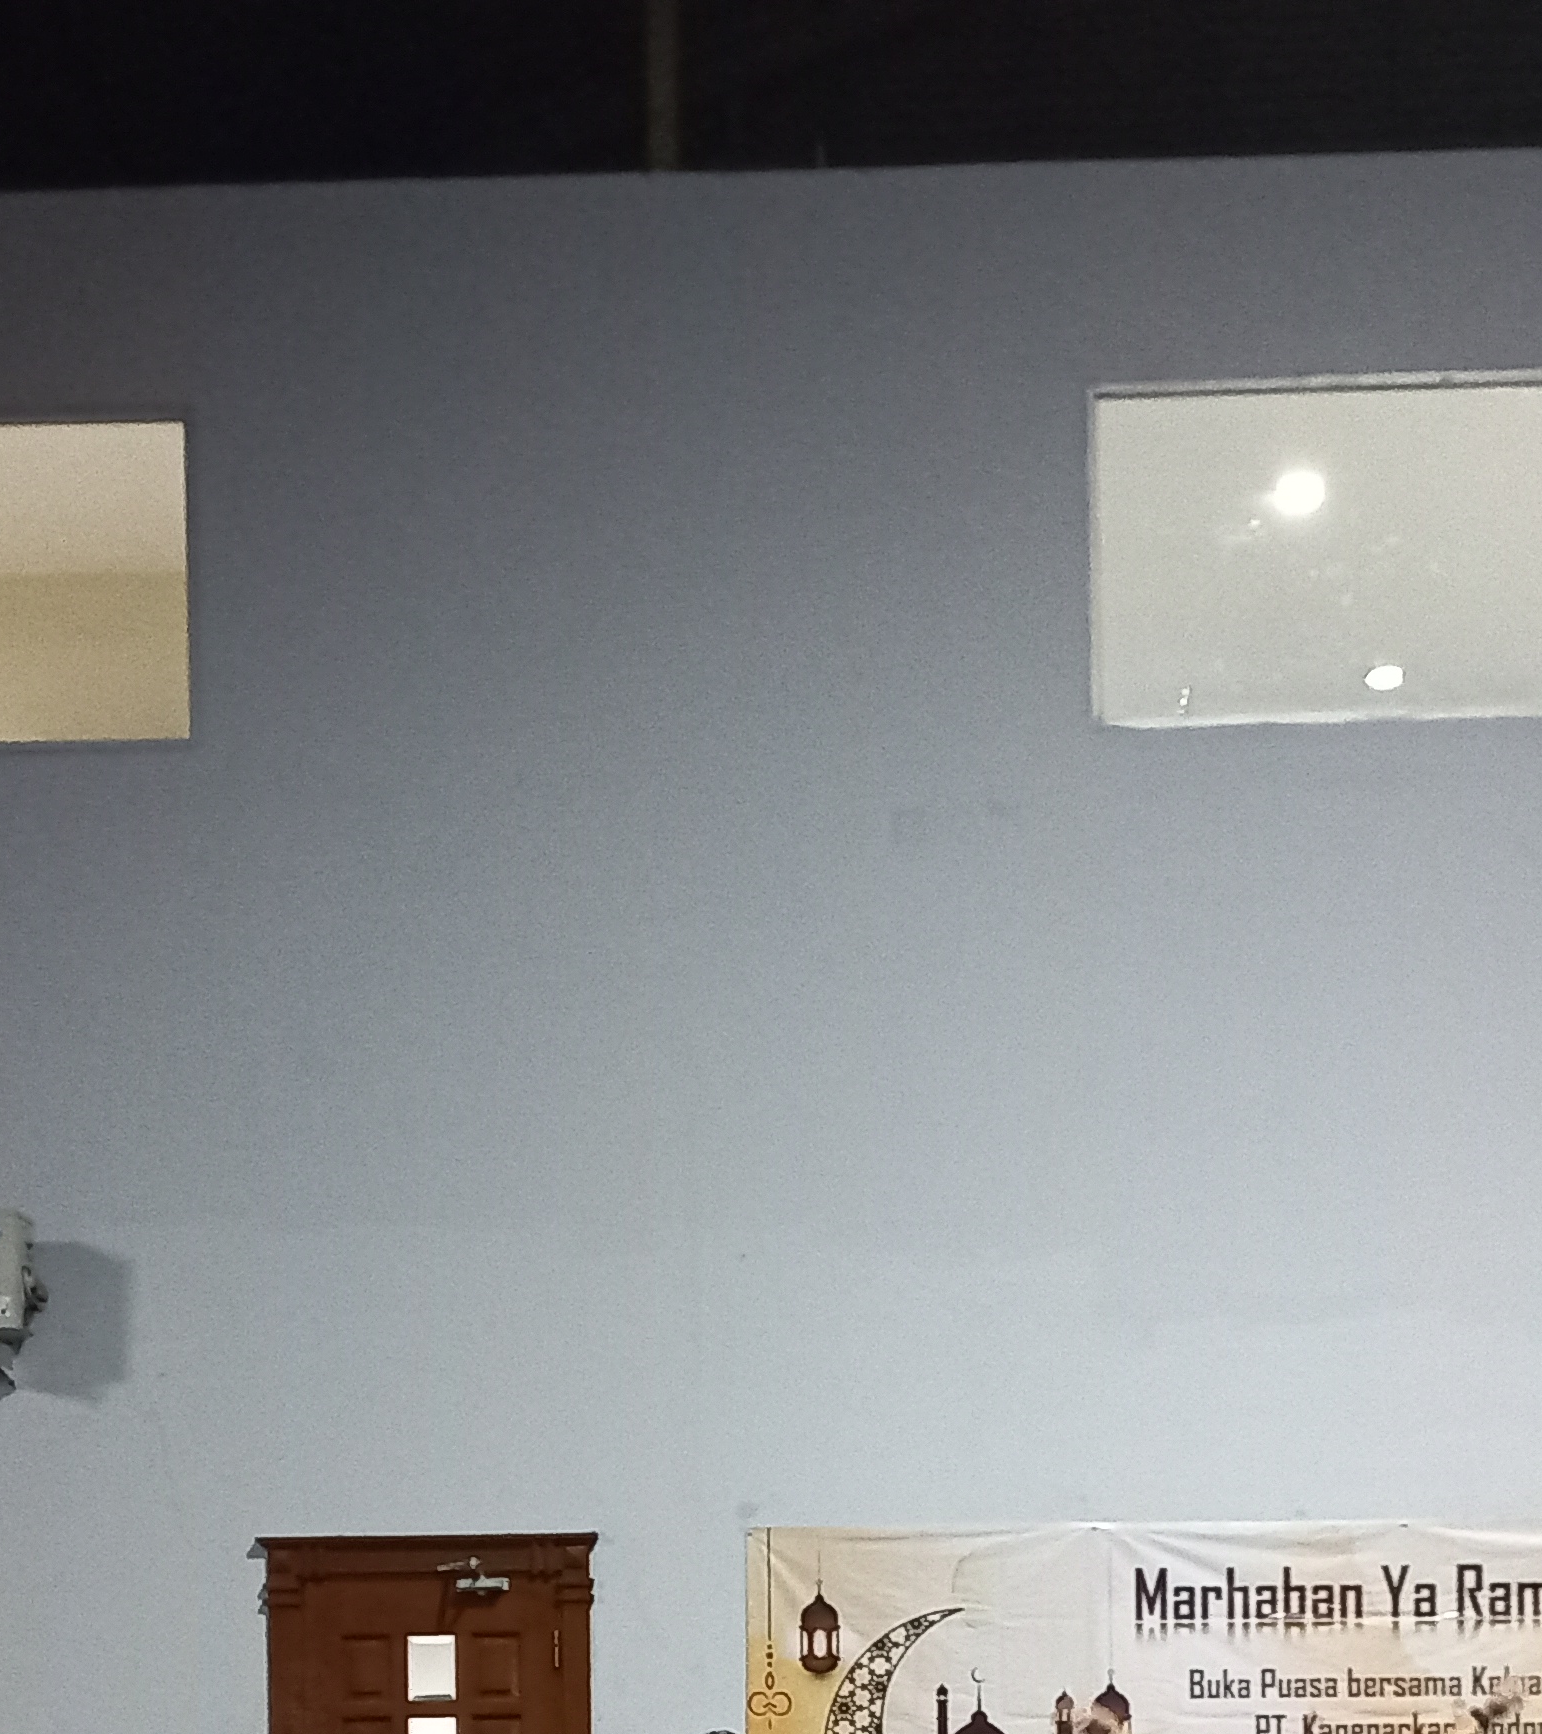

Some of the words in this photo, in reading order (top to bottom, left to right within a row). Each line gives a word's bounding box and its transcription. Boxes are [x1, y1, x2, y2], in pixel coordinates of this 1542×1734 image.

[1134, 1565, 1364, 1622] Marhaban
[1380, 1564, 1437, 1618] Ya
[1188, 1668, 1252, 1700] Buka
[1260, 1667, 1339, 1699] Puasa
[1347, 1666, 1462, 1699] bersama
